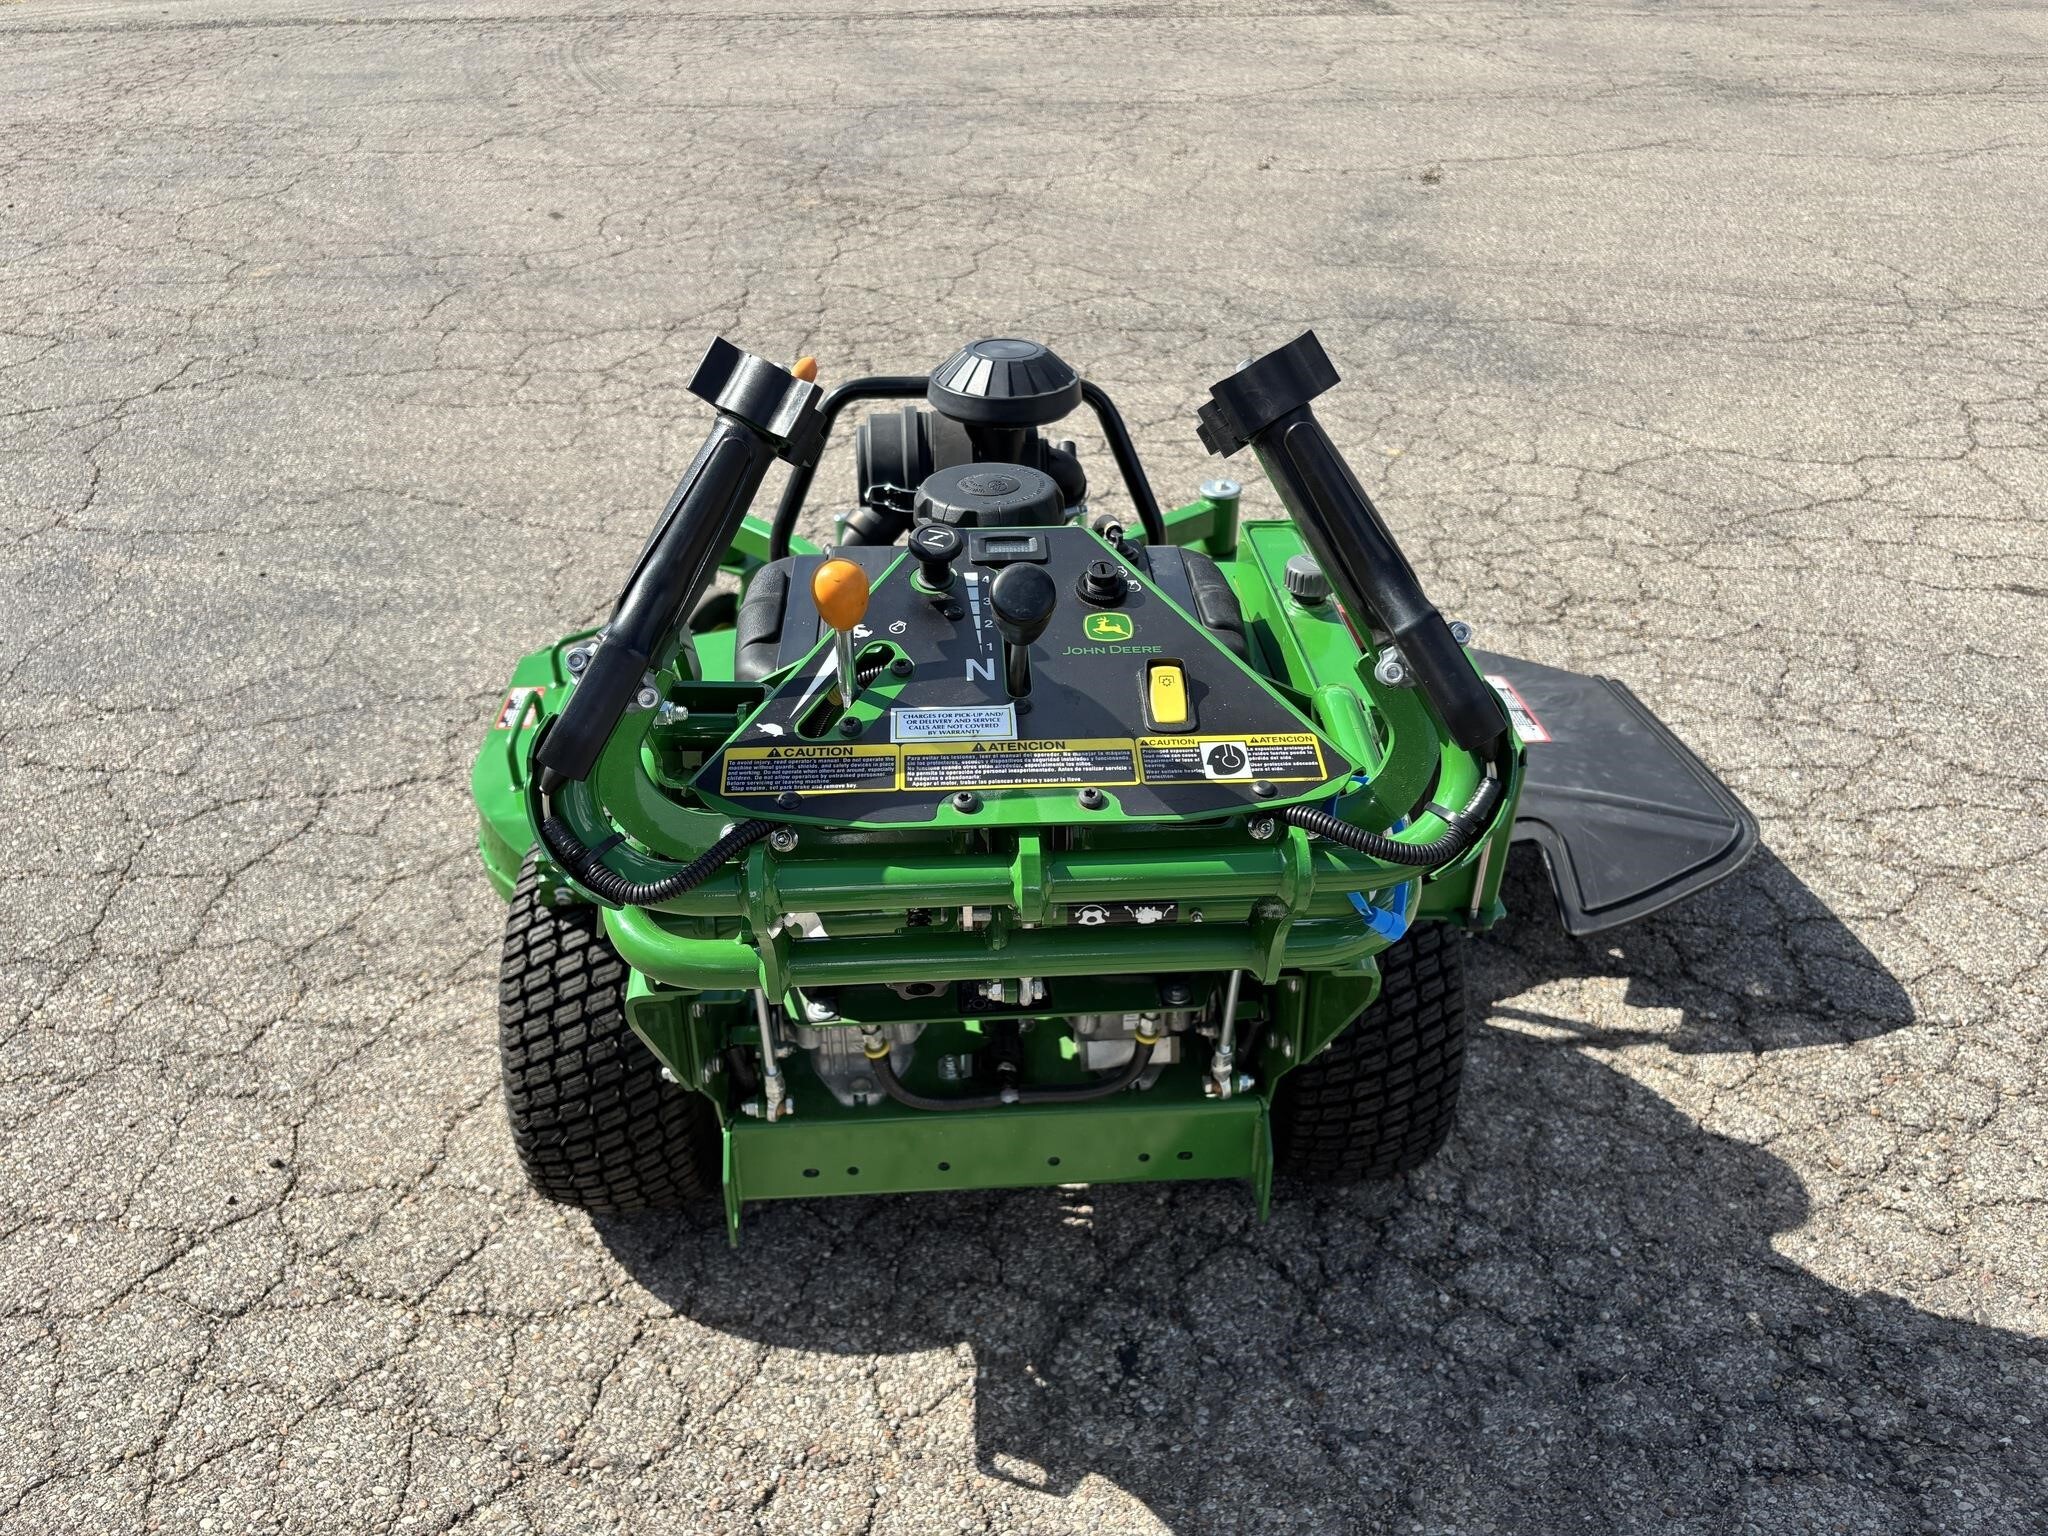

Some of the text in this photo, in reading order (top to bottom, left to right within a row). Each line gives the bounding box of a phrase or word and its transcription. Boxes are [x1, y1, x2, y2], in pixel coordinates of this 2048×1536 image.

[985, 620, 993, 628] 2
[1063, 645, 1163, 655] JOHN DEERE
[966, 658, 995, 681] N
[989, 741, 1065, 751] ATENCION
[784, 748, 853, 757] CAUTION
